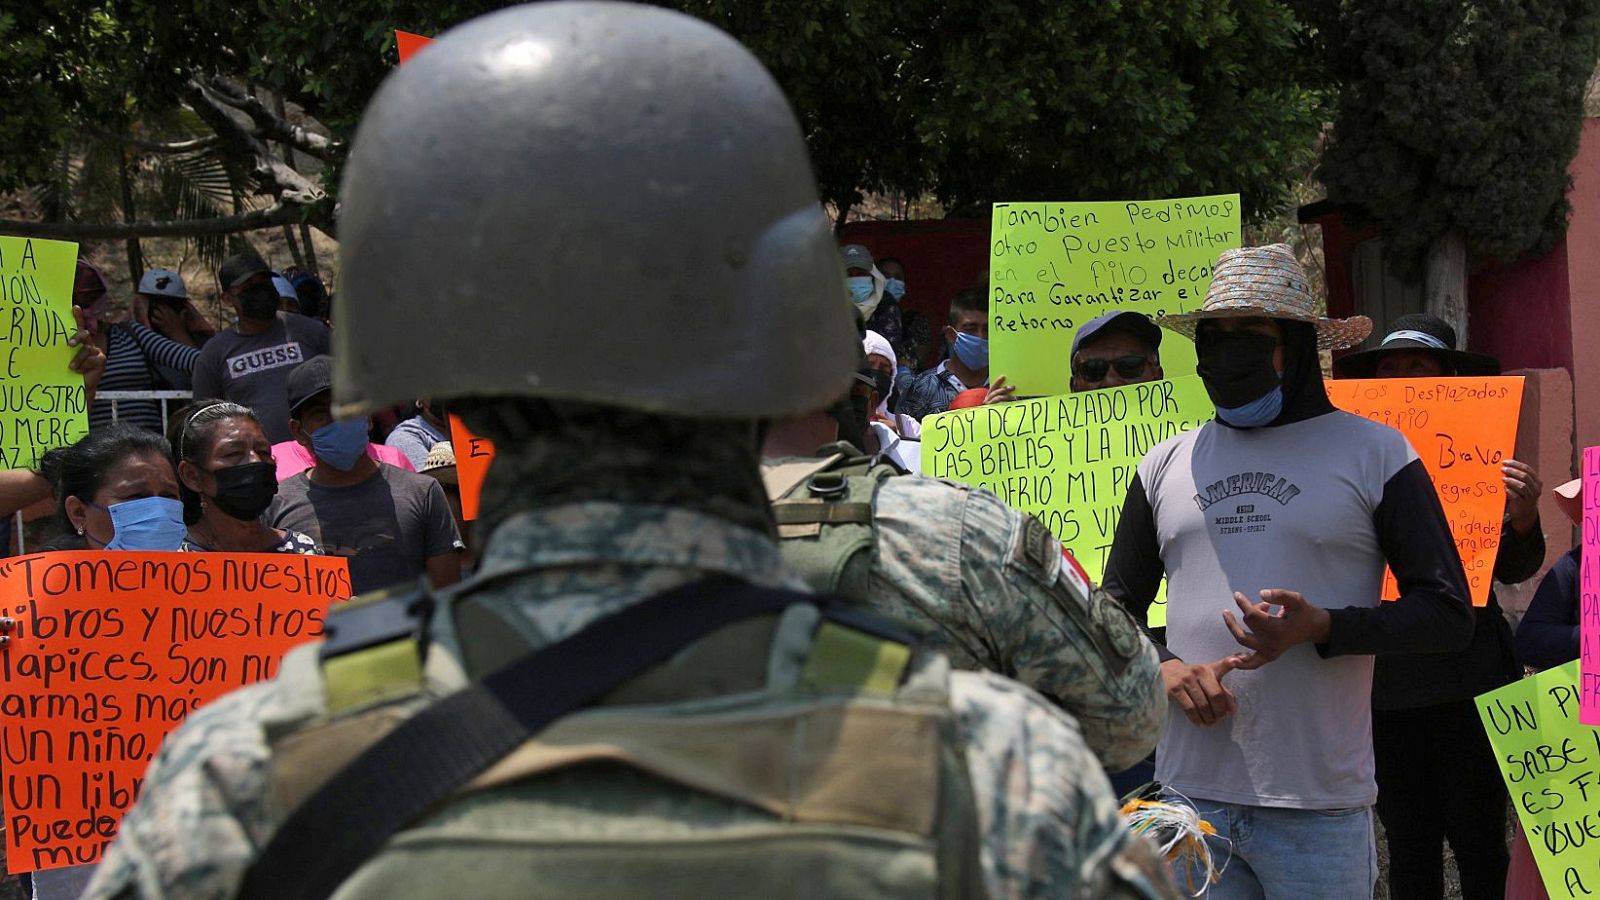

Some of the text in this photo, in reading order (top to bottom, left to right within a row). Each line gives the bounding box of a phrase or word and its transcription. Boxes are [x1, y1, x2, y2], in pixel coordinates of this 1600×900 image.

[996, 200, 1234, 232] Tambien Pedimos
[1167, 226, 1234, 250] Militar
[22, 239, 36, 270] A
[995, 269, 1017, 281] en
[1036, 261, 1061, 283] el
[1049, 283, 1162, 305] Garantizar
[994, 313, 1074, 332] Retorno
[232, 346, 298, 372] GUESS
[934, 380, 1179, 452] SOY DEZPLAZADO POR
[934, 449, 973, 478] LAS
[1064, 433, 1075, 465] Y
[1086, 427, 1111, 463] LA
[1067, 470, 1096, 503] MI
[1193, 472, 1301, 511] AMERICAN
[1216, 514, 1272, 525] MIDDLE SCHOOL
[223, 558, 352, 600] nuestros
[171, 602, 325, 643] nuestros
[168, 644, 226, 684] Son
[1, 692, 122, 723] armas
[1487, 699, 1537, 735] UN
[4, 726, 53, 765] Un
[1506, 738, 1588, 783] SABE
[1522, 788, 1564, 815] ES
[1565, 867, 1592, 898] A
